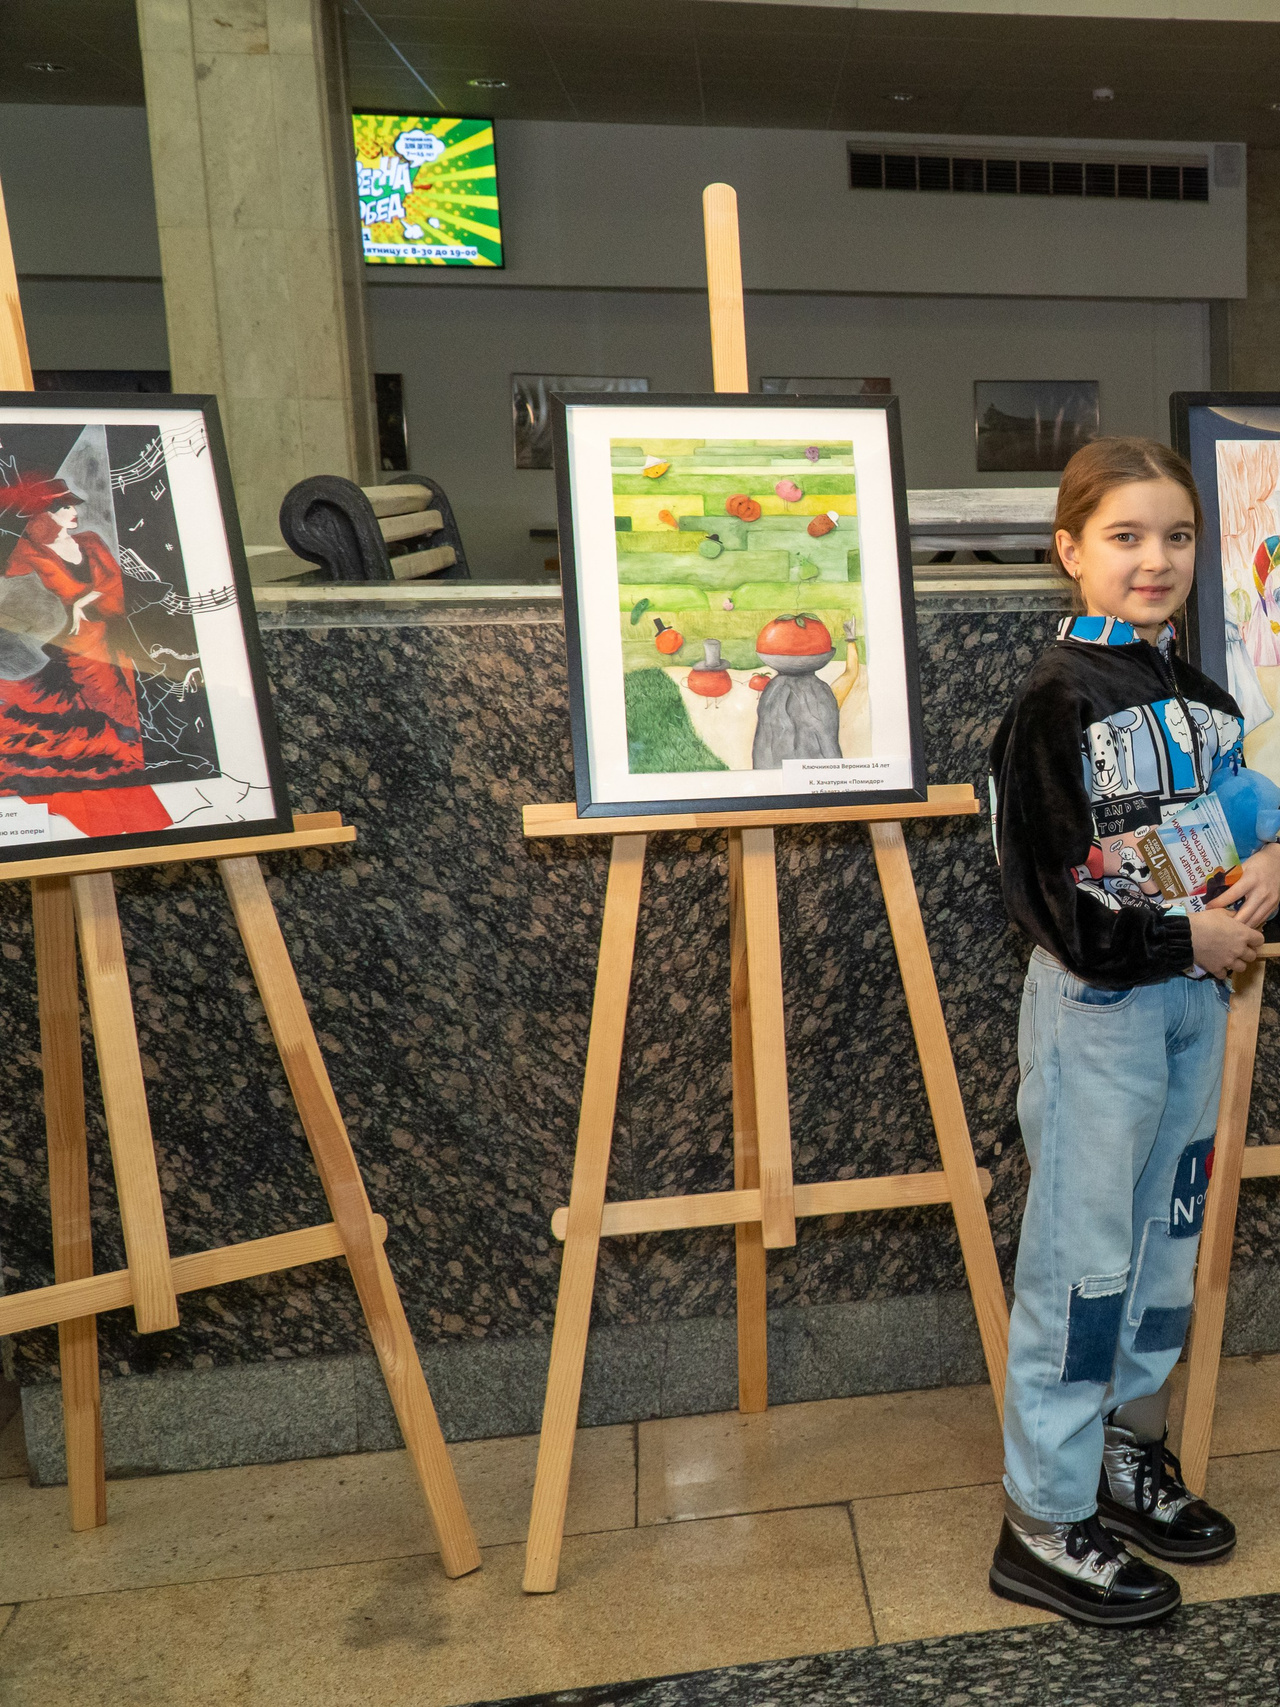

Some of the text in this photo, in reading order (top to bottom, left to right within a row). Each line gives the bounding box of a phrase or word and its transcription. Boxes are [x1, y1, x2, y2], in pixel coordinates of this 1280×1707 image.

[365, 247, 400, 256] ятницу
[411, 247, 432, 256] 8-30
[450, 249, 477, 257] 19-00
[1104, 802, 1132, 818] AND
[1098, 819, 1125, 835] TOY
[1171, 818, 1200, 865] ДОМИСОЛЬКИ
[1188, 827, 1212, 868] ОРКЕСТРОМ
[1150, 853, 1167, 869] 17
[1179, 855, 1198, 886] КОНЦЕРТ
[1194, 865, 1206, 879] ДЛЯ
